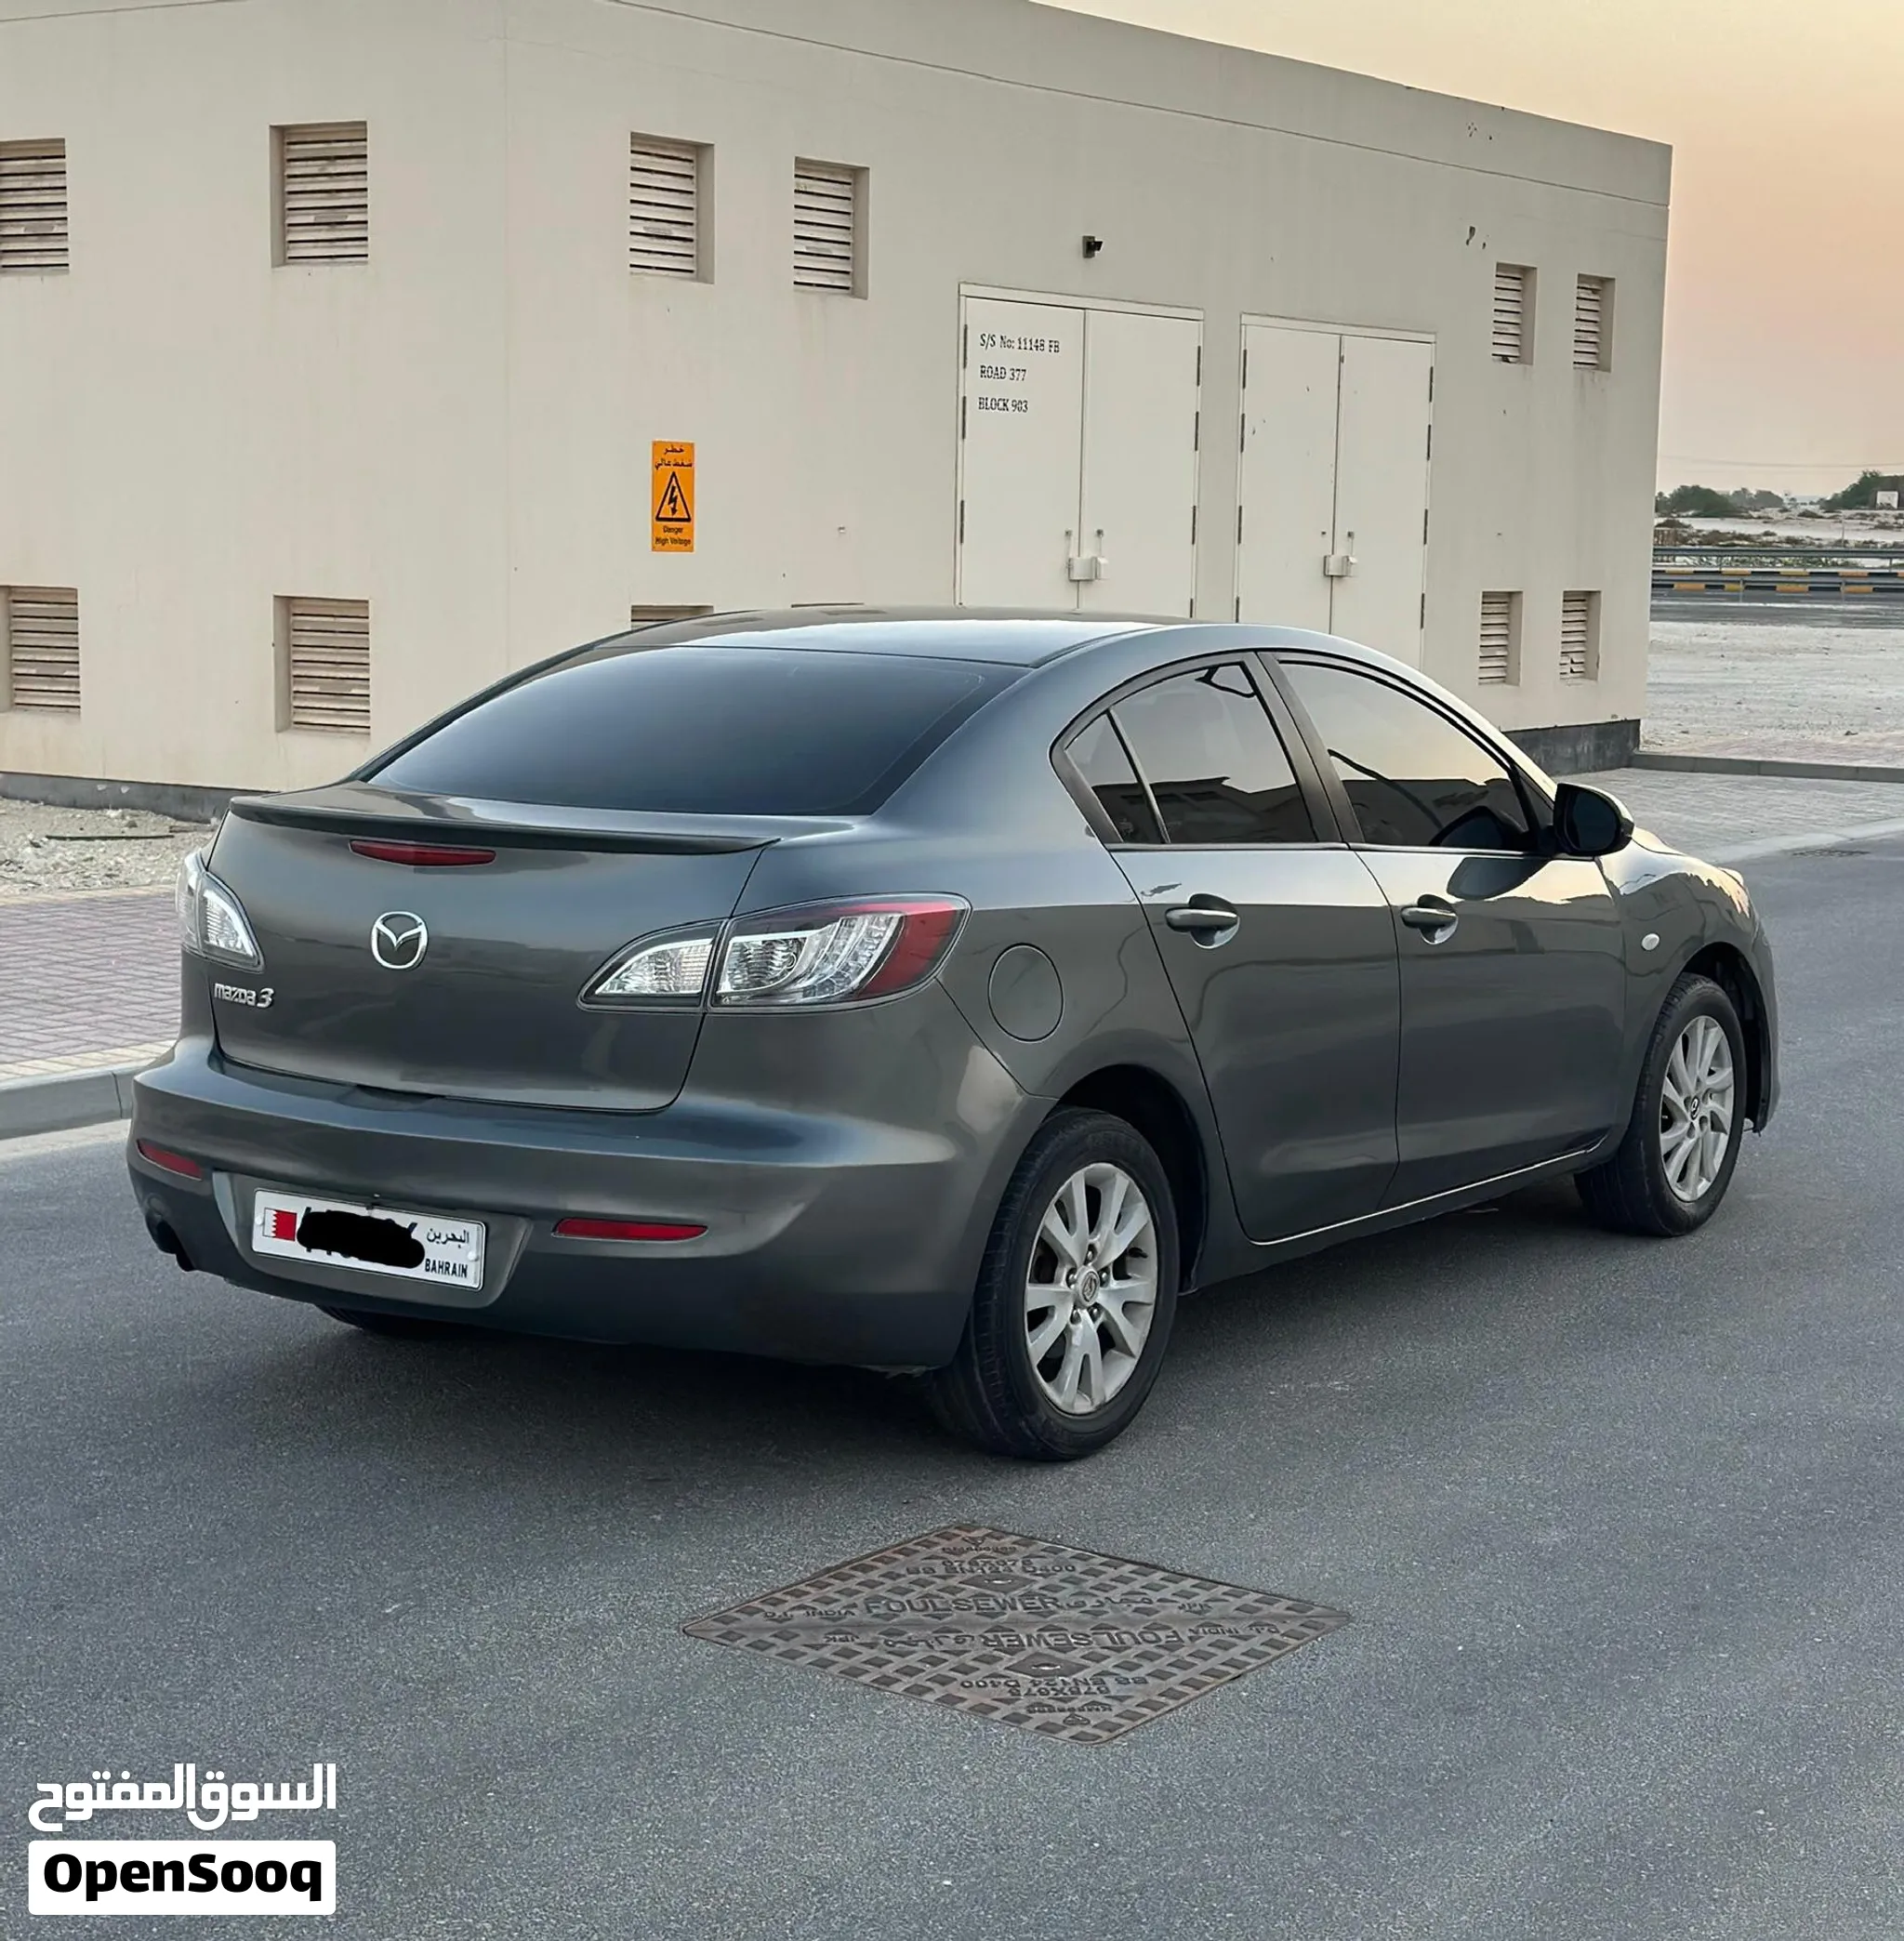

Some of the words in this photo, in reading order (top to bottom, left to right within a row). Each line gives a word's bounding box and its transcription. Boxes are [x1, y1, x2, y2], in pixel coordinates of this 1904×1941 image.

[980, 333, 997, 350] S/S
[999, 335, 1015, 350] No:
[1049, 339, 1060, 353] FB
[980, 364, 1007, 380] ROAD
[1010, 367, 1026, 381] 377
[978, 396, 1010, 412] BLOCK
[1012, 399, 1028, 414] 903
[663, 525, 683, 535] Danger
[654, 536, 668, 547] High
[426, 1227, 469, 1248] البحرين
[425, 1258, 468, 1278] BAHRAIN
